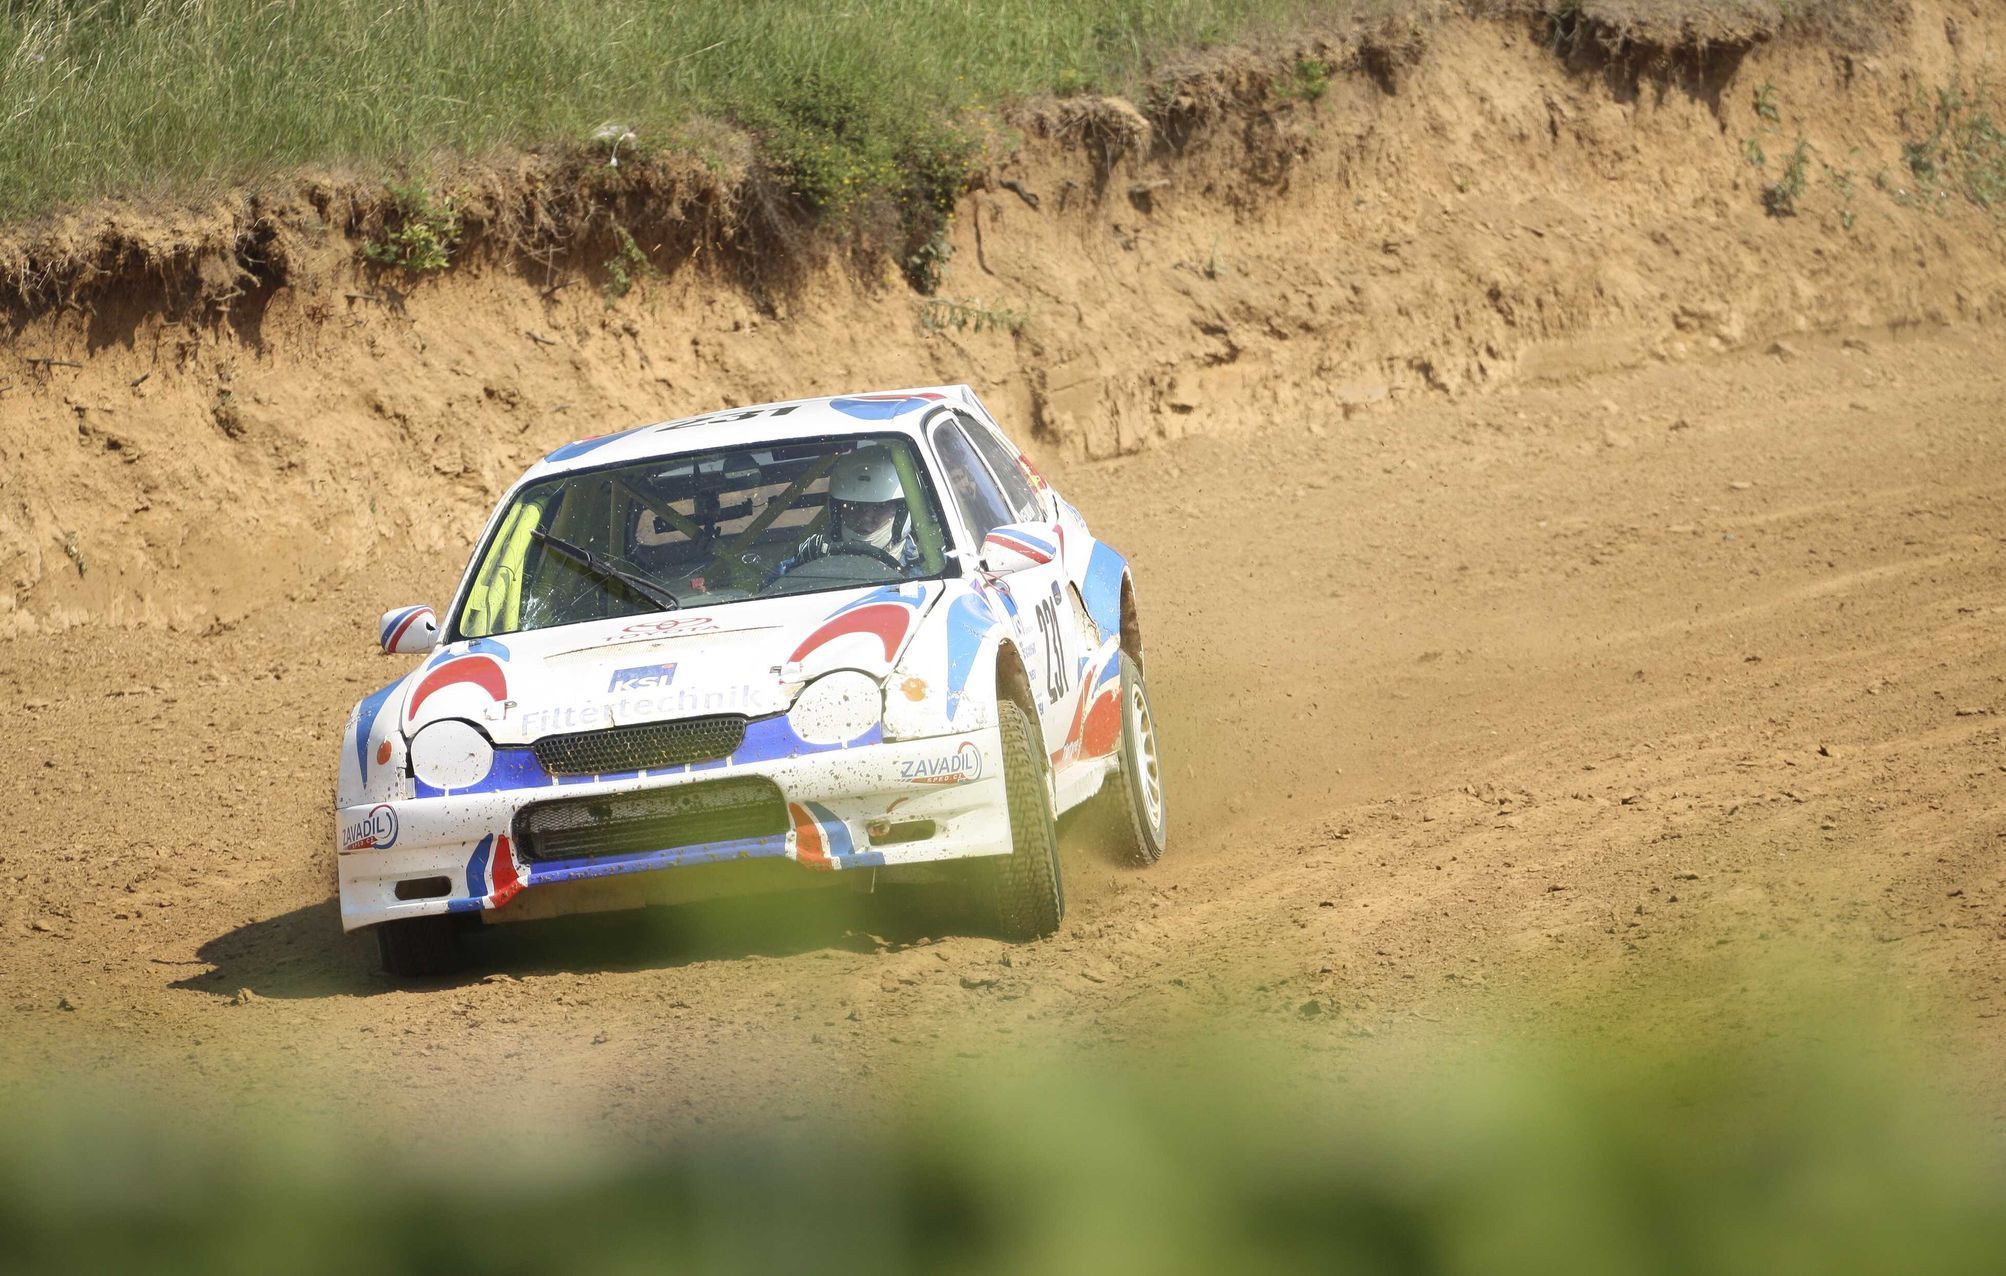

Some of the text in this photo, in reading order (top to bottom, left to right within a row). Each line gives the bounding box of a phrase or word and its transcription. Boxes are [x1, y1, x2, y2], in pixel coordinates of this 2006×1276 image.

[655, 405, 801, 432] 231
[603, 624, 720, 642] TOYOTA
[1035, 596, 1069, 704] 231
[521, 685, 764, 737] Filtertechnik
[901, 753, 973, 778] ZAVADIL
[343, 816, 384, 845] ZAVADIL
